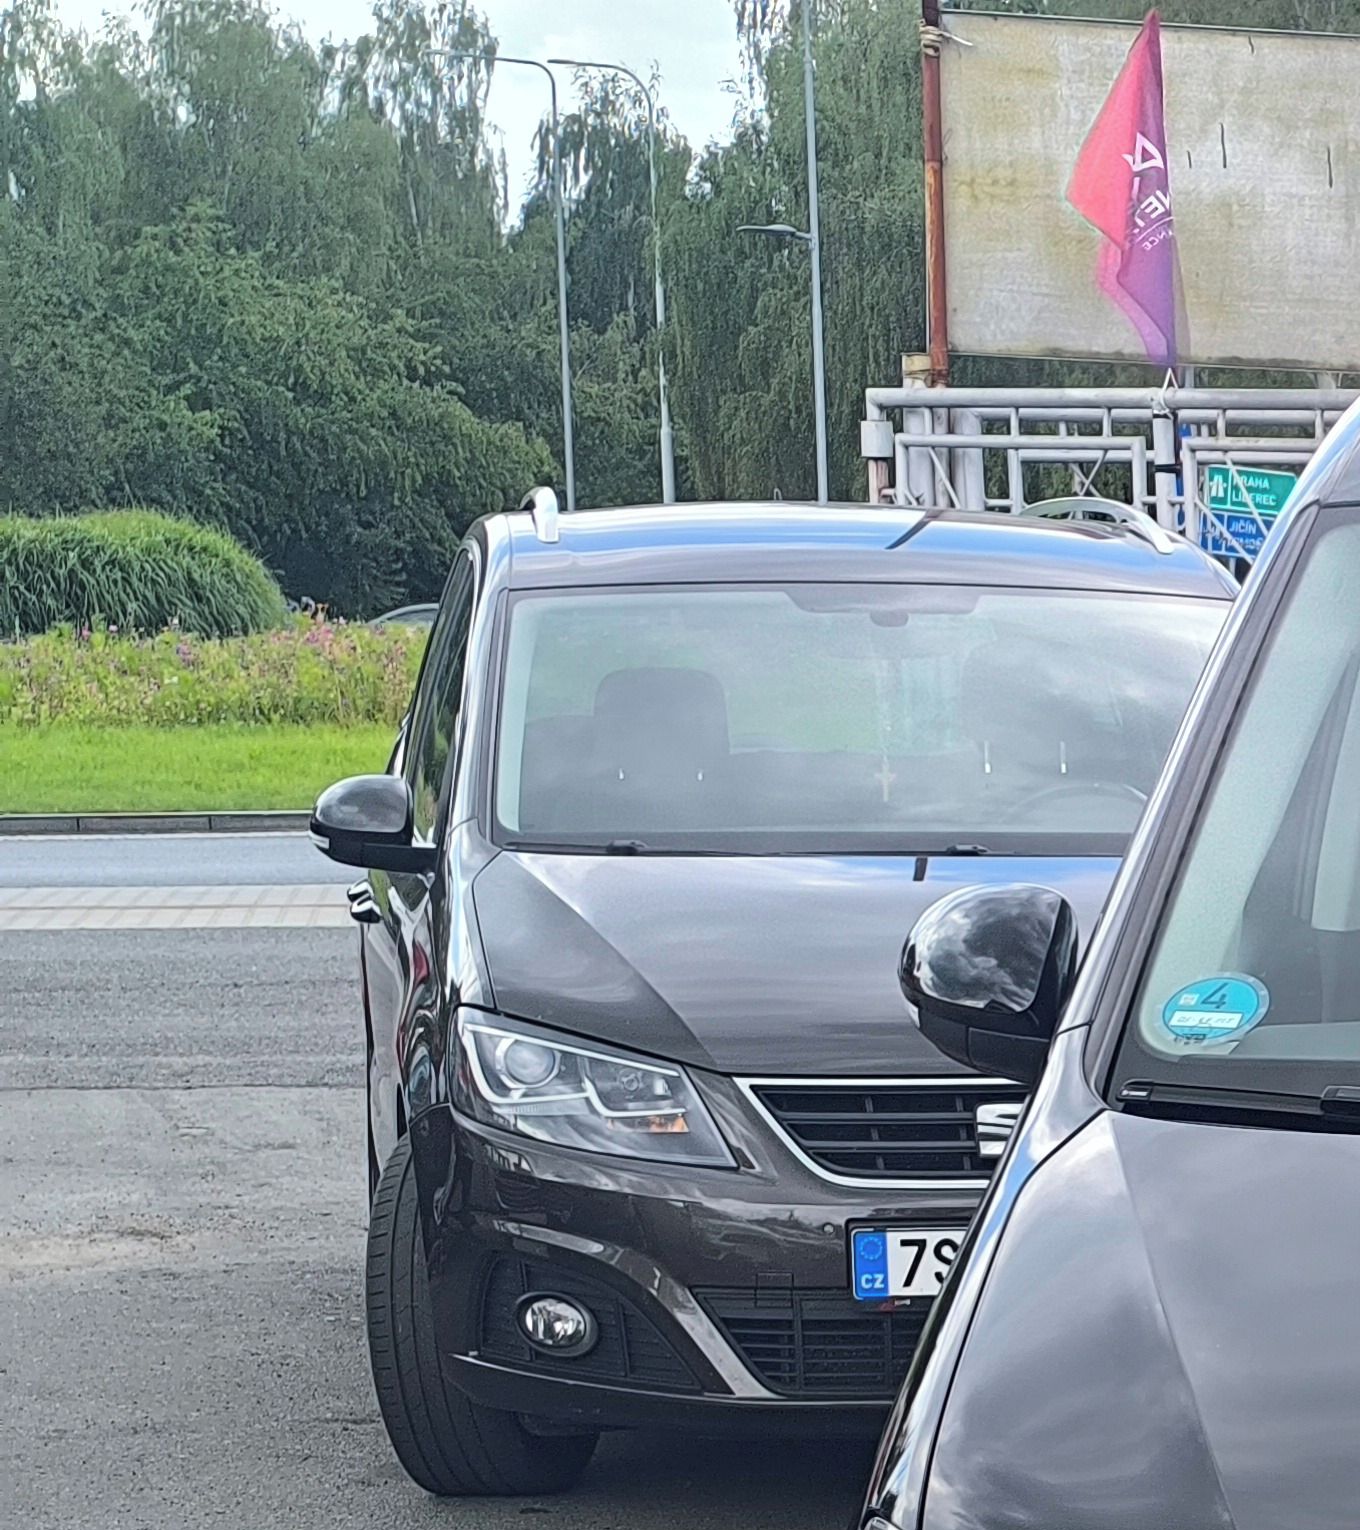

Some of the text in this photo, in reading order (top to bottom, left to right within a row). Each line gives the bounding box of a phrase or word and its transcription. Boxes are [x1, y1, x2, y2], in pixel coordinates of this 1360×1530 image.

[1229, 519, 1257, 534] JIČÍN
[1201, 982, 1229, 1009] 4
[900, 1238, 960, 1288] 7S
[861, 1273, 885, 1289] CZ
